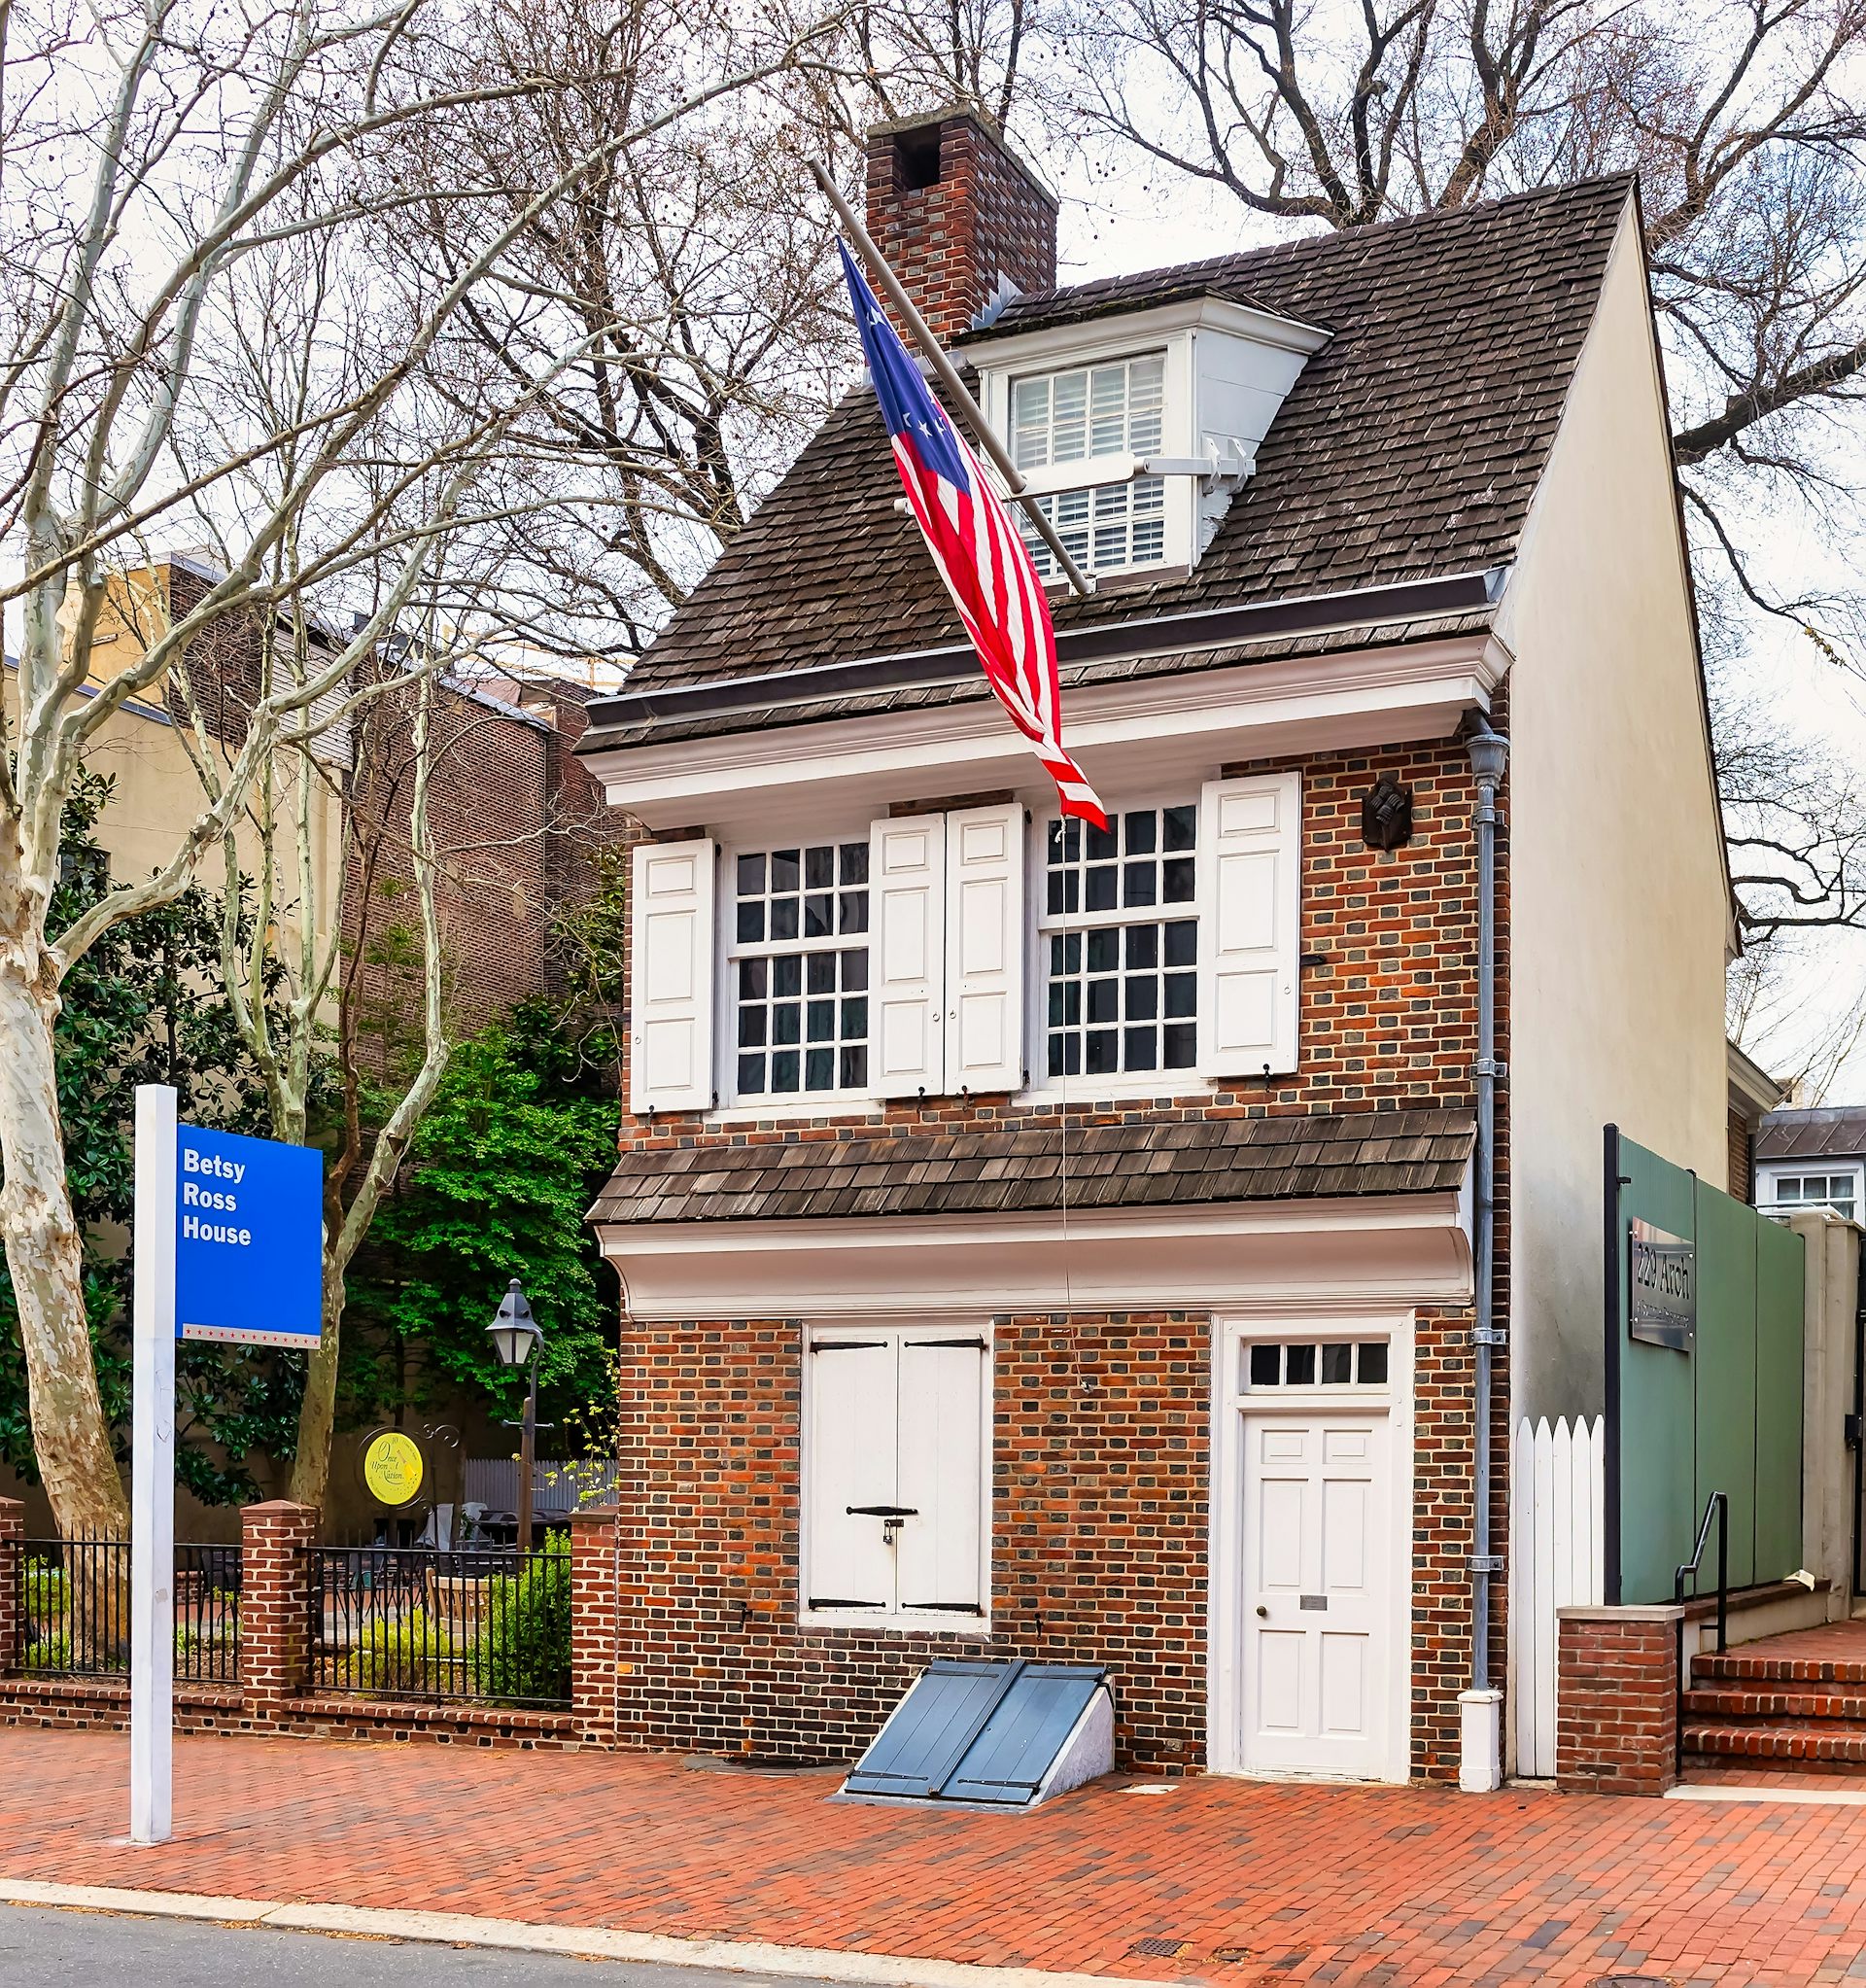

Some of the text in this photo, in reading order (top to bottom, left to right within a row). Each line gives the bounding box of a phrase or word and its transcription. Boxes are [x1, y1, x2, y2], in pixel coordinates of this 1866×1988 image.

[184, 1148, 246, 1184] Betsy
[184, 1182, 237, 1211] Ross
[183, 1216, 252, 1246] House
[1638, 1242, 1690, 1300] 229 Arch
[378, 1440, 397, 1463] Once
[371, 1461, 388, 1473] Upon
